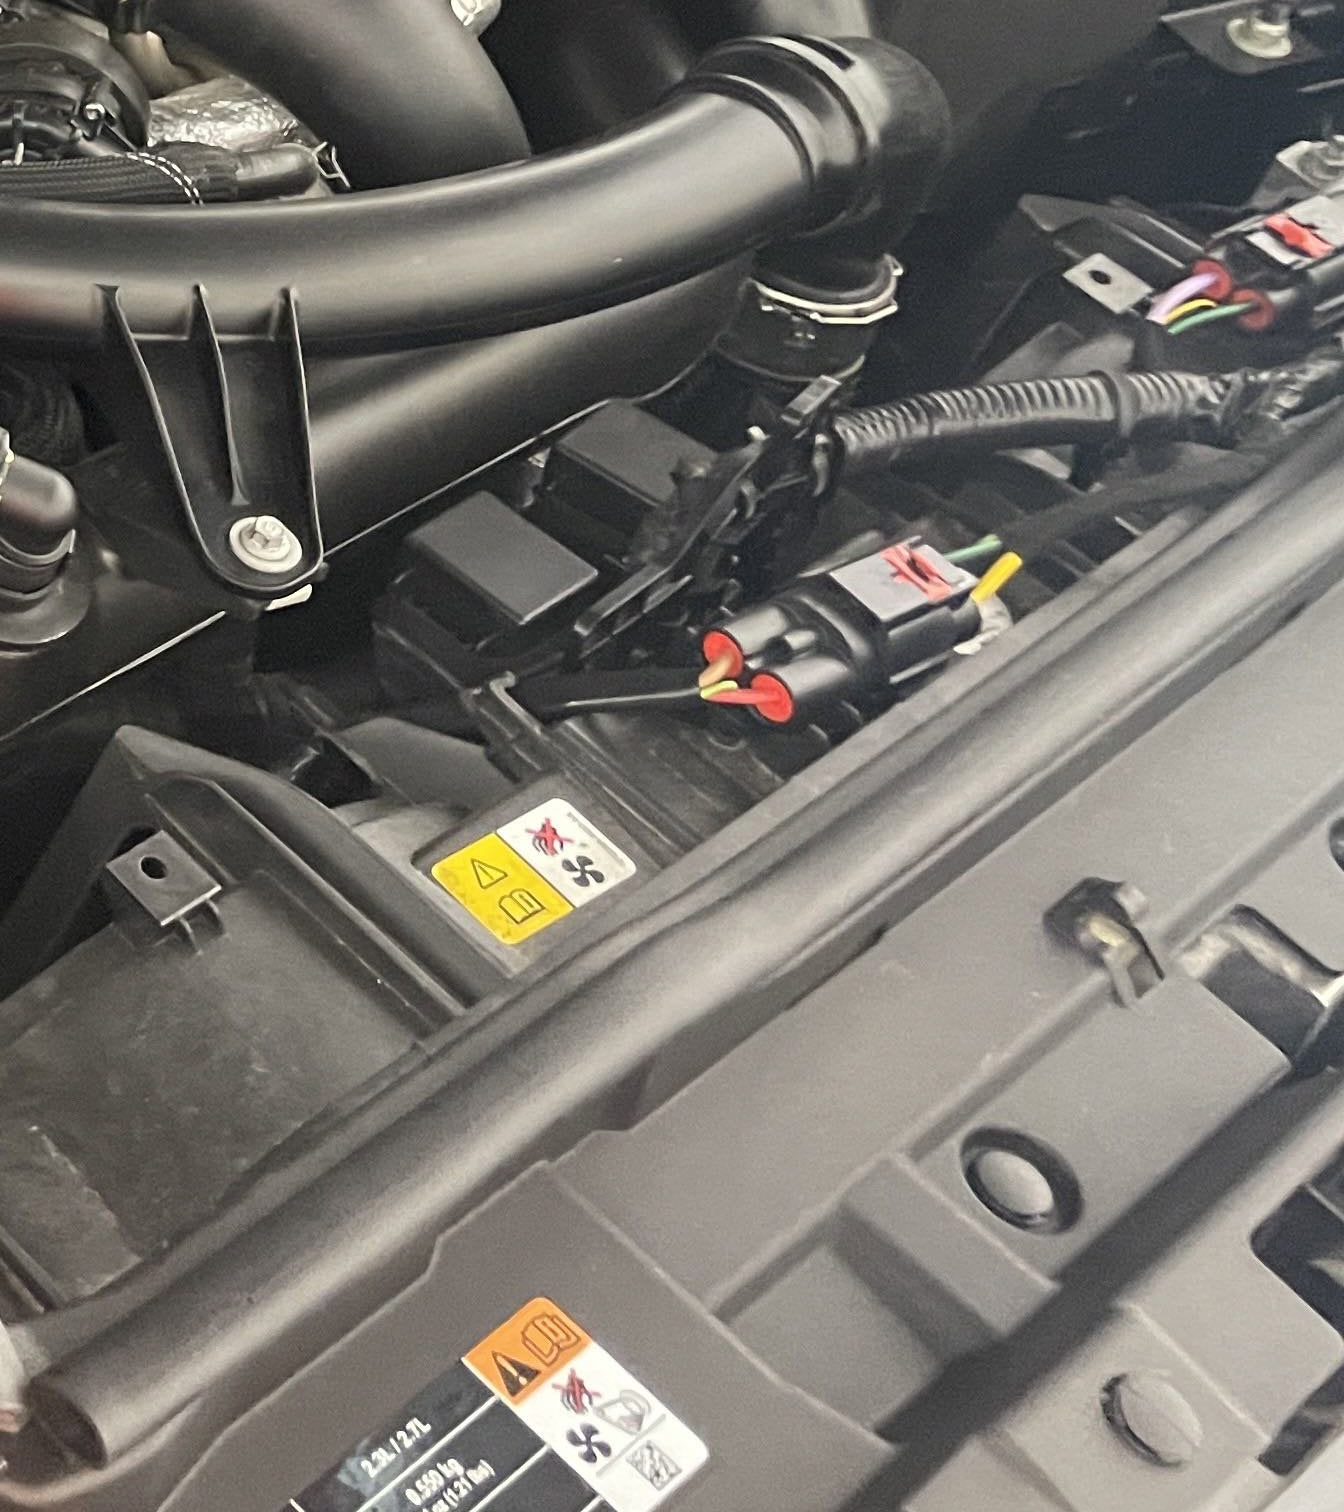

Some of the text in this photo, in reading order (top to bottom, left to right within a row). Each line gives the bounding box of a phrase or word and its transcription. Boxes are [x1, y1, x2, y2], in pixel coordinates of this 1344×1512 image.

[361, 1447, 396, 1478] 2.3L
[397, 1417, 431, 1448] 2.7L
[437, 1458, 465, 1479] kg
